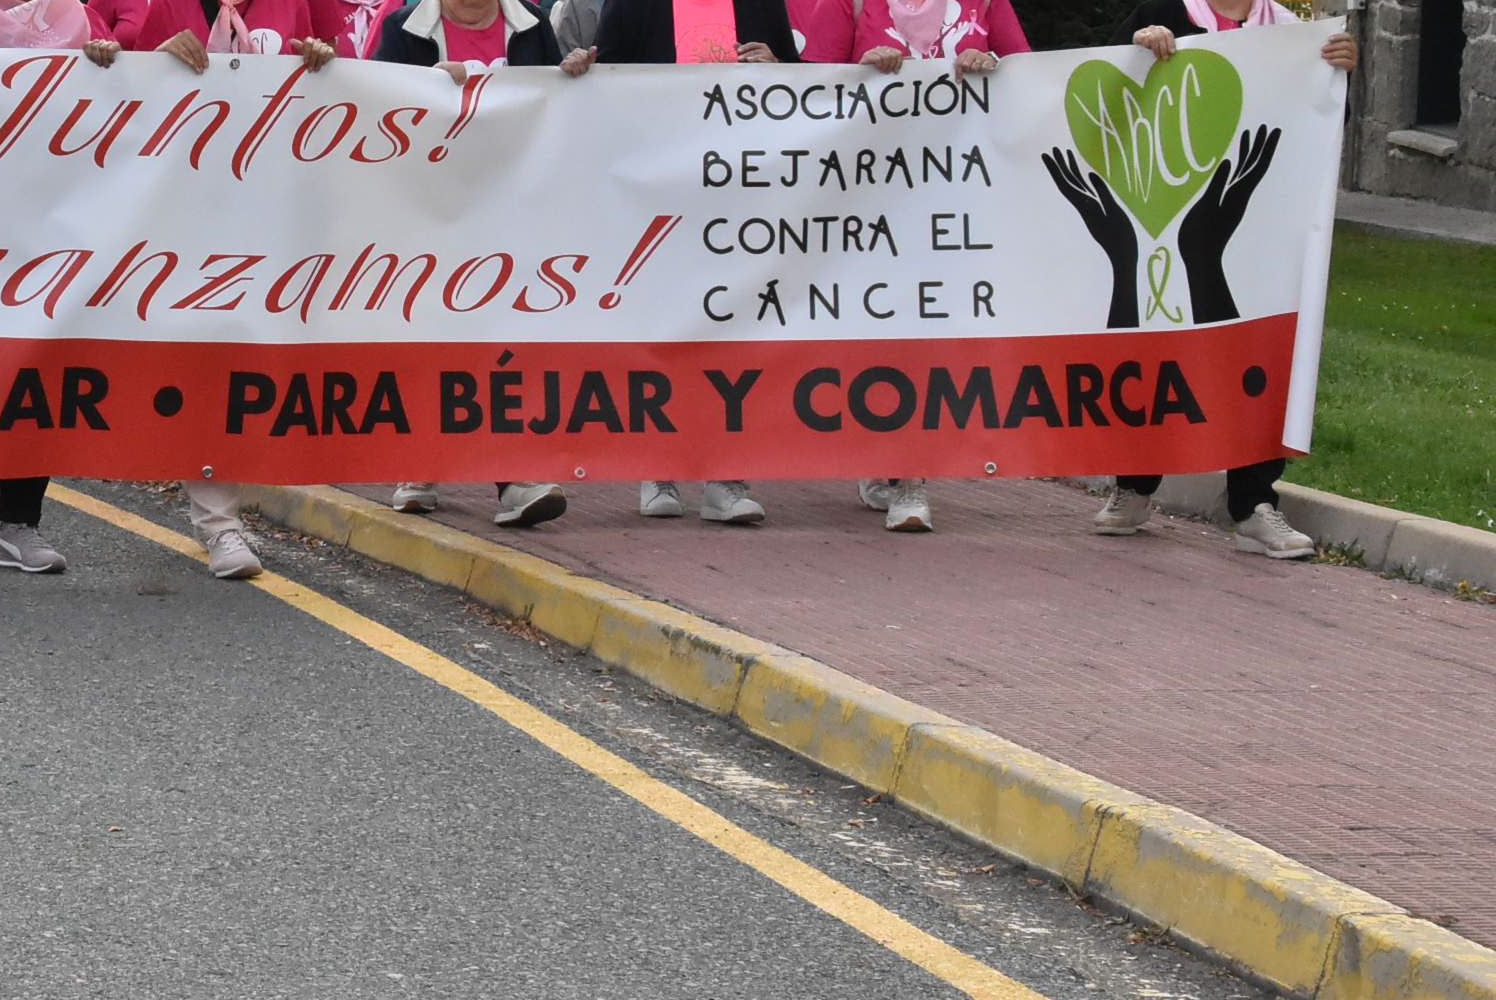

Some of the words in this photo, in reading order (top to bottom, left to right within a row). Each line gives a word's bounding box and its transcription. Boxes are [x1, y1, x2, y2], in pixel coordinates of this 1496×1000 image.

[703, 73, 989, 126] ASOCIACIÓN
[1073, 62, 1217, 203] ABCC
[703, 145, 992, 189] BEJARANA
[703, 214, 898, 257] CONTRA
[931, 213, 993, 251] EL
[703, 279, 996, 326] CÁNCER
[225, 371, 411, 437] PARA
[440, 351, 677, 435] BÉJAR
[704, 369, 762, 432] Y
[794, 360, 1207, 432] COMARCA
